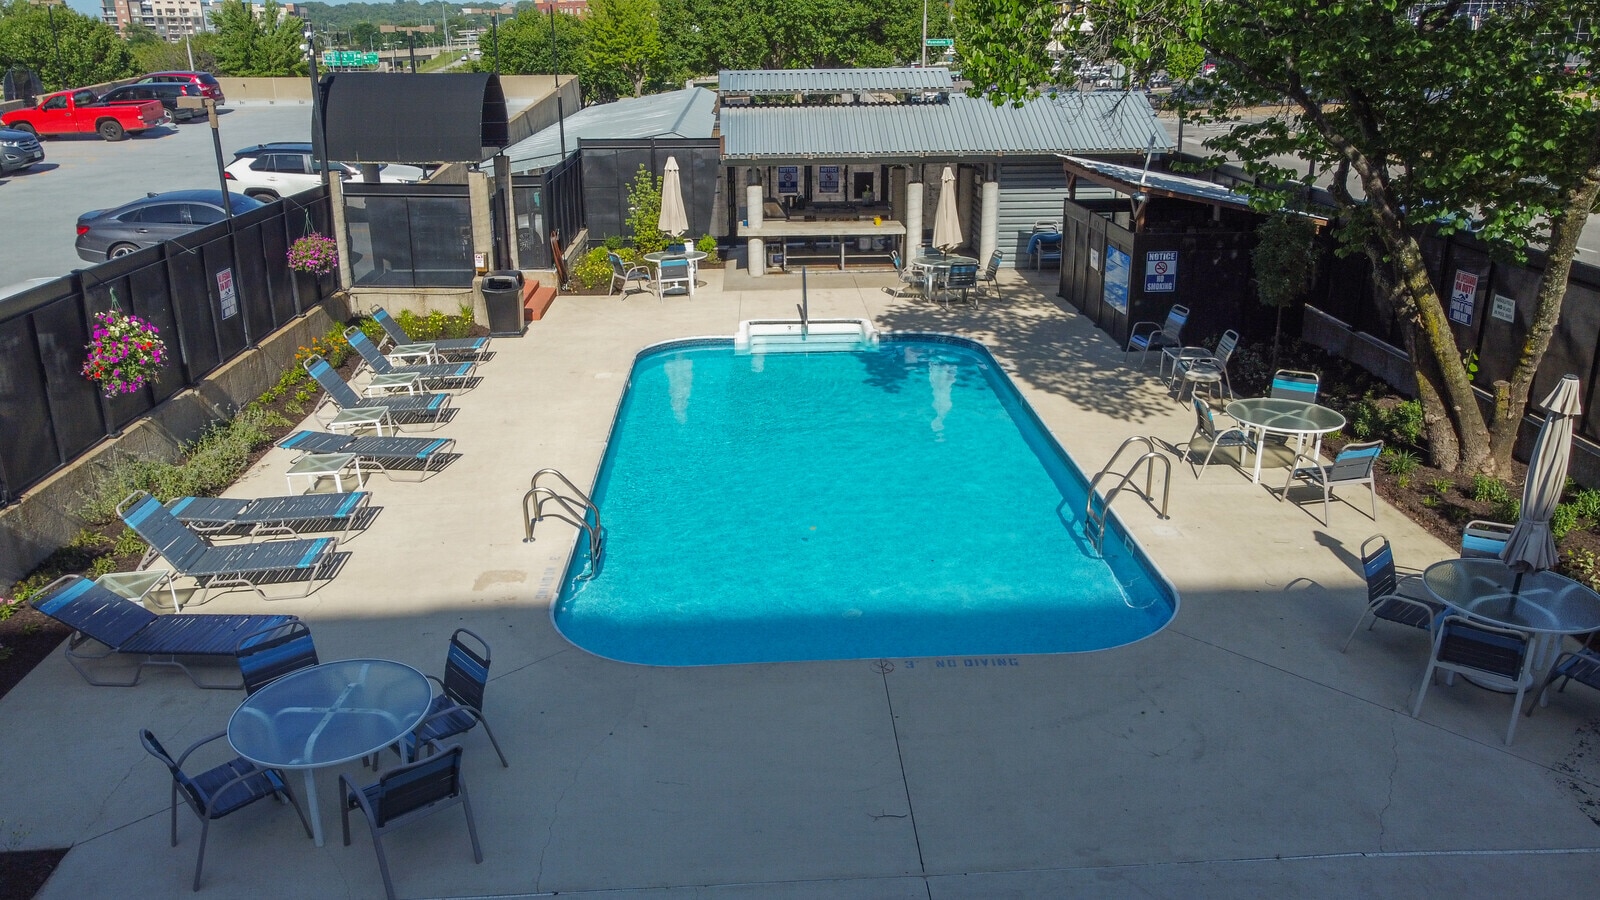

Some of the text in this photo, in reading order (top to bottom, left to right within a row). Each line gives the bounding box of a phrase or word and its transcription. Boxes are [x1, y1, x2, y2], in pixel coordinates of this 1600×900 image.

[1149, 252, 1175, 261] NOTICE
[1156, 275, 1166, 283] NO
[1147, 282, 1173, 291] SMOKING
[936, 659, 957, 668] NO
[963, 657, 1019, 667] DIVING
